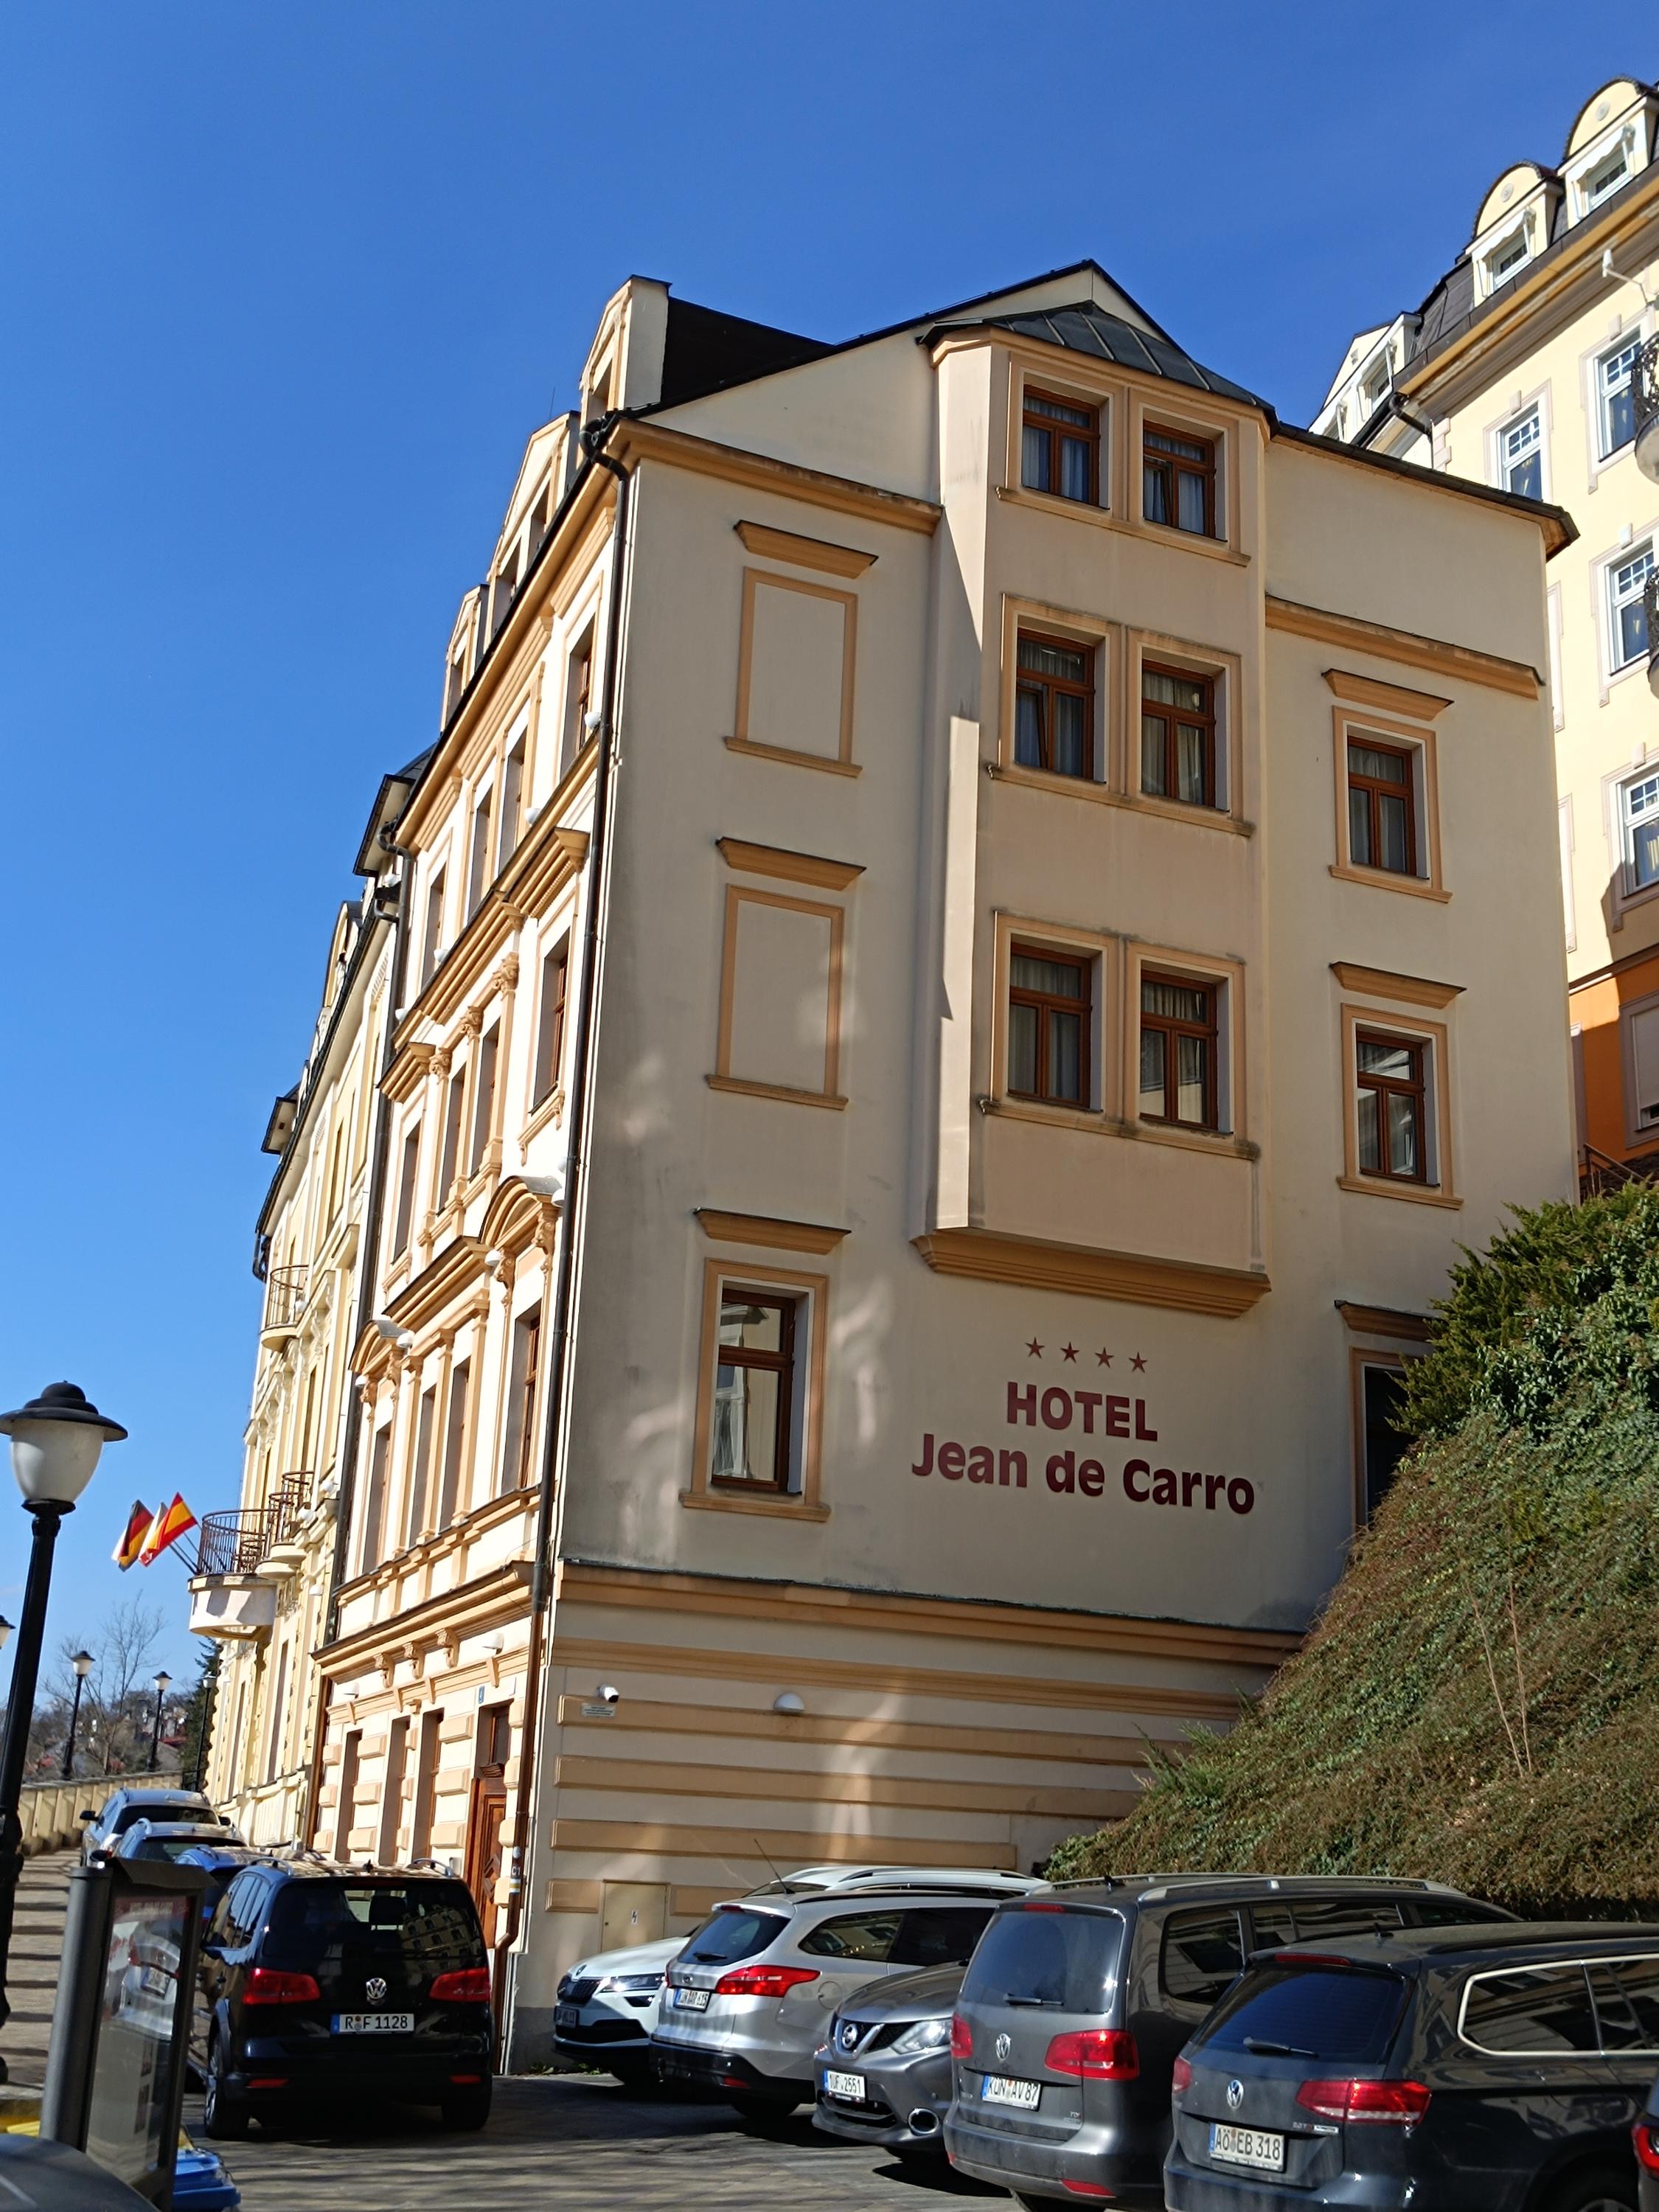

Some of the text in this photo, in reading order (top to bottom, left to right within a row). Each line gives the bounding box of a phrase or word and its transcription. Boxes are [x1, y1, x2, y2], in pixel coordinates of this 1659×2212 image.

[1007, 1381, 1158, 1441] HOTEL
[911, 1433, 1254, 1514] Jean de Carro
[345, 2015, 408, 2030] R F 1128
[1237, 2132, 1253, 2155] EB
[1256, 2135, 1281, 2160] 318
